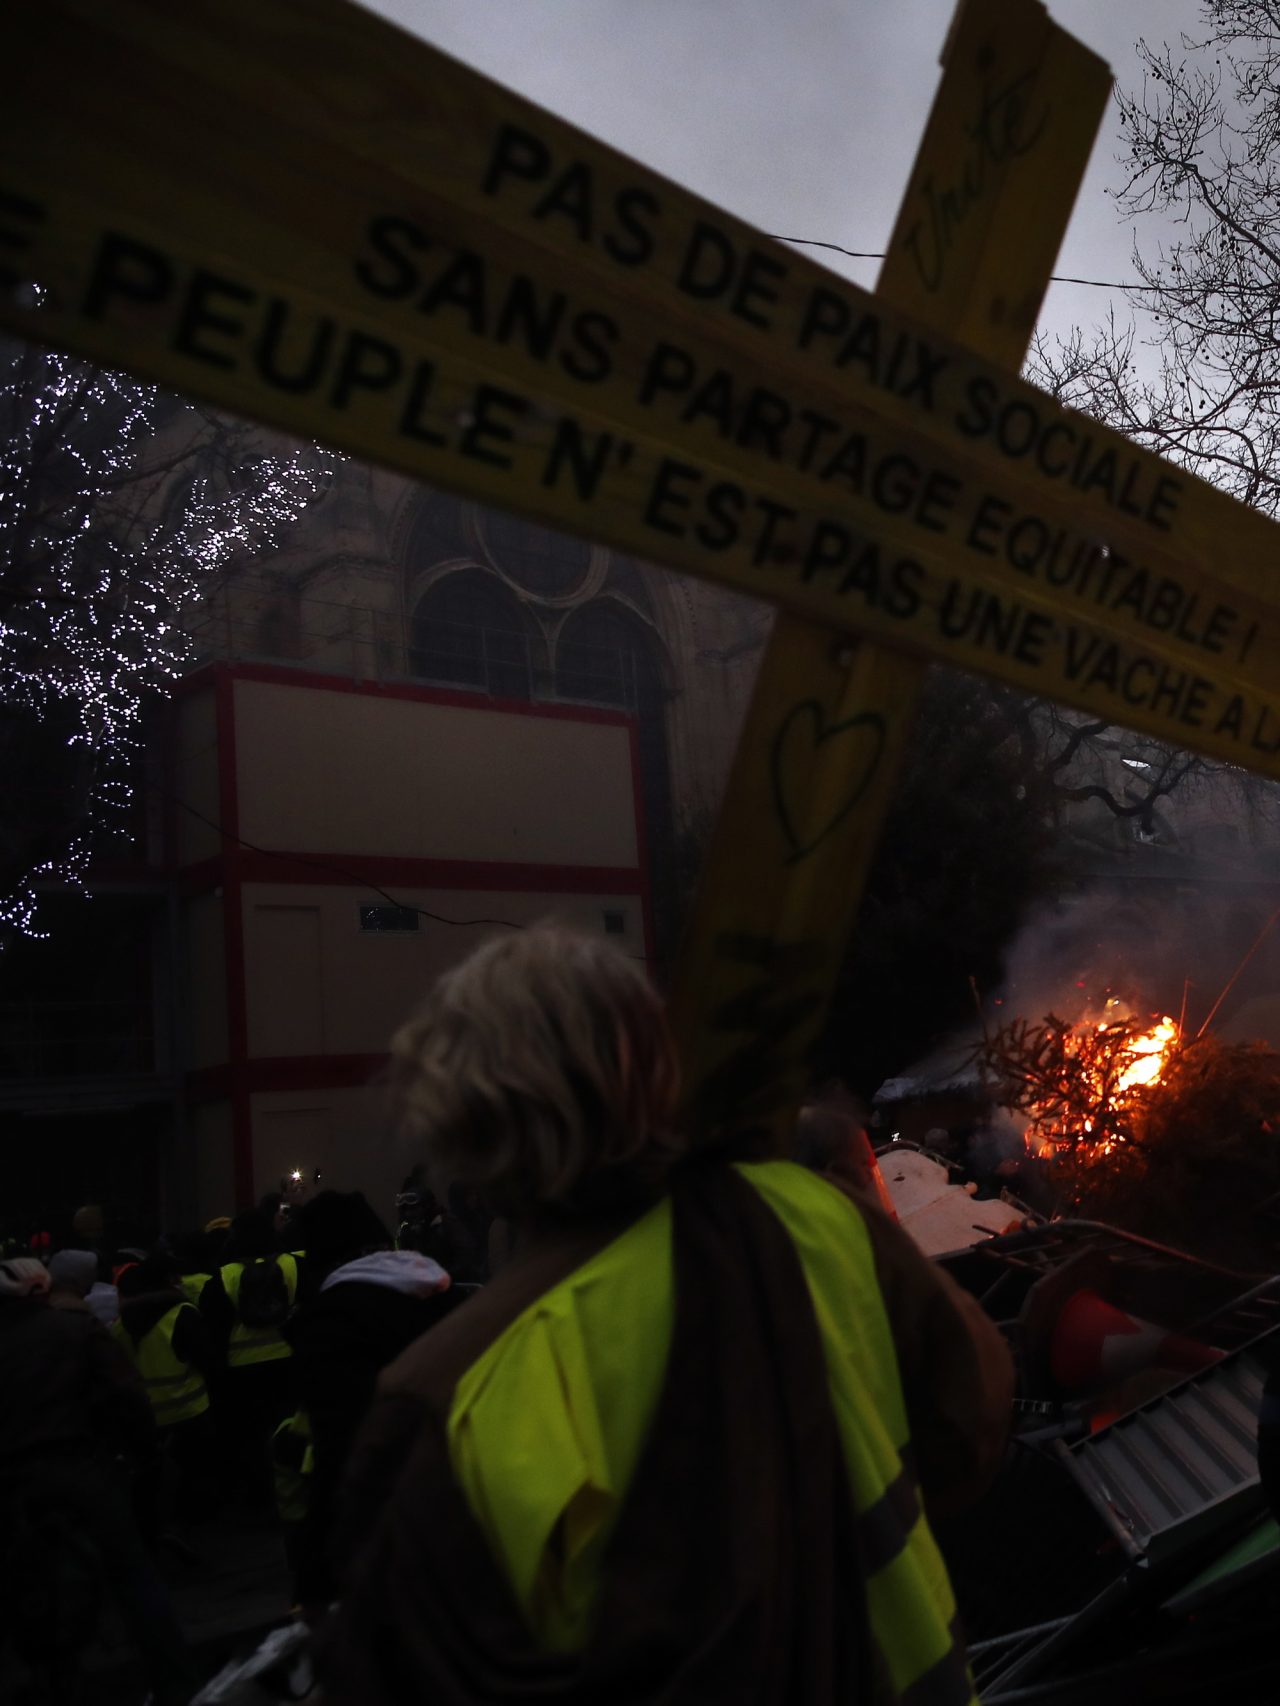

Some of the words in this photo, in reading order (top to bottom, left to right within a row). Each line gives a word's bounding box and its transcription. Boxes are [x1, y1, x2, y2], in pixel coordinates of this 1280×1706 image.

[81, 231, 530, 471] PEUPLE
[800, 518, 924, 620] PAS
[938, 577, 1056, 667] UNE
[1062, 626, 1214, 727] VACHE
[1213, 694, 1244, 741] A
[354, 214, 620, 384] SANS
[640, 343, 962, 533] PARTAGE
[966, 496, 1237, 654] EQUITABLE
[482, 124, 662, 269] PAS
[680, 223, 787, 328] DE
[797, 289, 948, 410] PAIX
[958, 376, 1183, 530] SOCIALE
